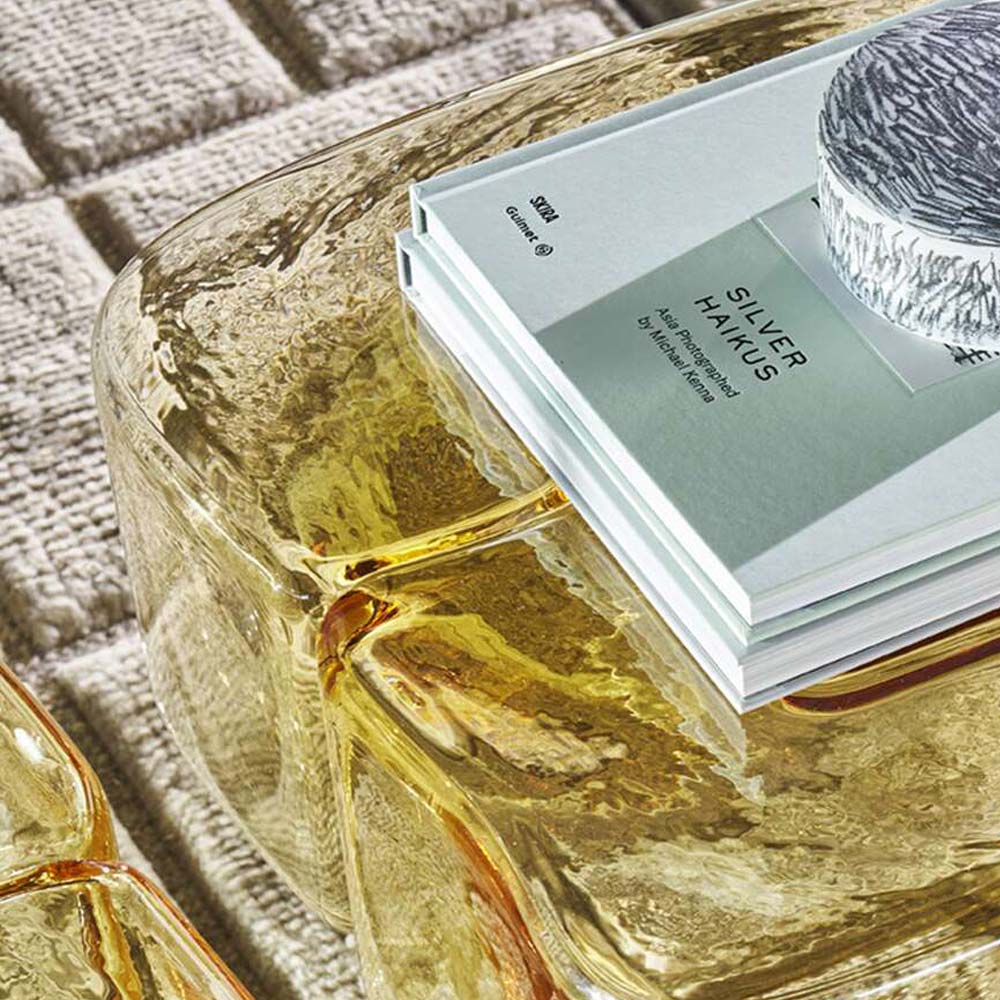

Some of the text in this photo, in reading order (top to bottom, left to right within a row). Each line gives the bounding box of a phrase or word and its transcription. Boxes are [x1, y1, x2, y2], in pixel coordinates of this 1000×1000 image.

[637, 315, 716, 404] by Michael Kenna
[655, 307, 741, 399] Asia Photographed
[694, 295, 779, 382] HAIKUS
[726, 287, 808, 369] SILVER
